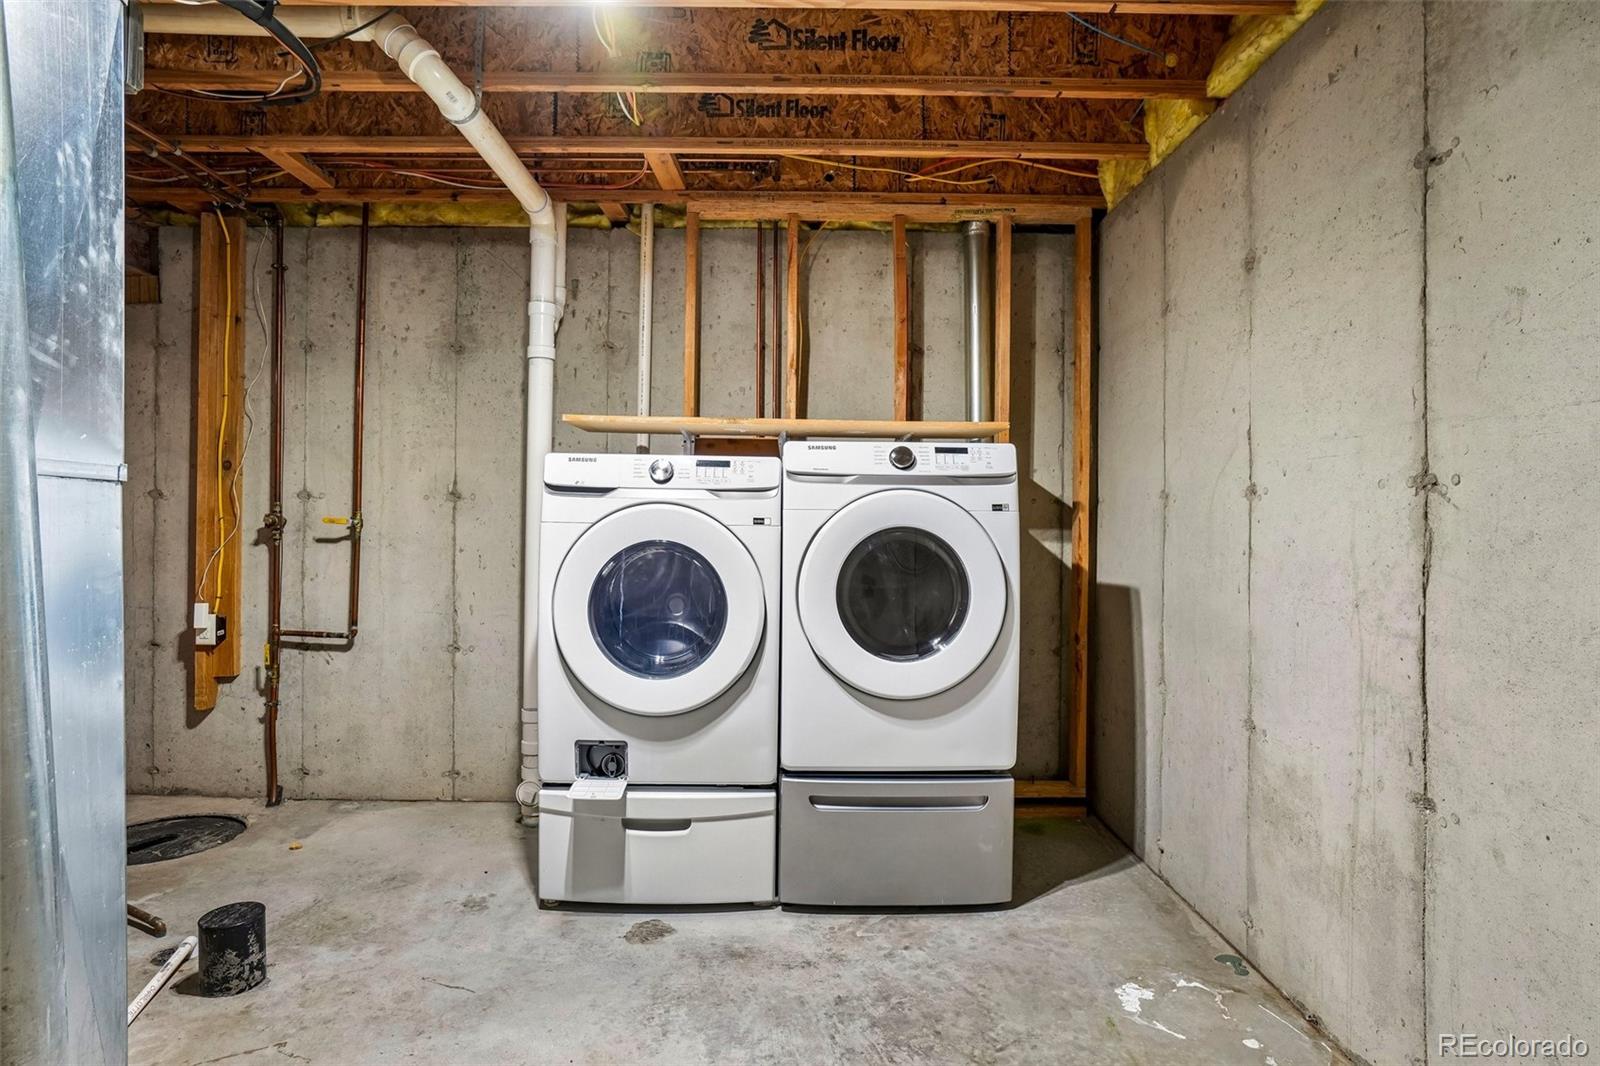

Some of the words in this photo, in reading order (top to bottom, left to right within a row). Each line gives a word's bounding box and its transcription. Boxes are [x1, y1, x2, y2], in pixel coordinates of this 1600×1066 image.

[793, 28, 847, 51] Silent
[852, 29, 900, 52] Floor
[736, 99, 782, 118] Silent
[786, 99, 829, 119] Floor
